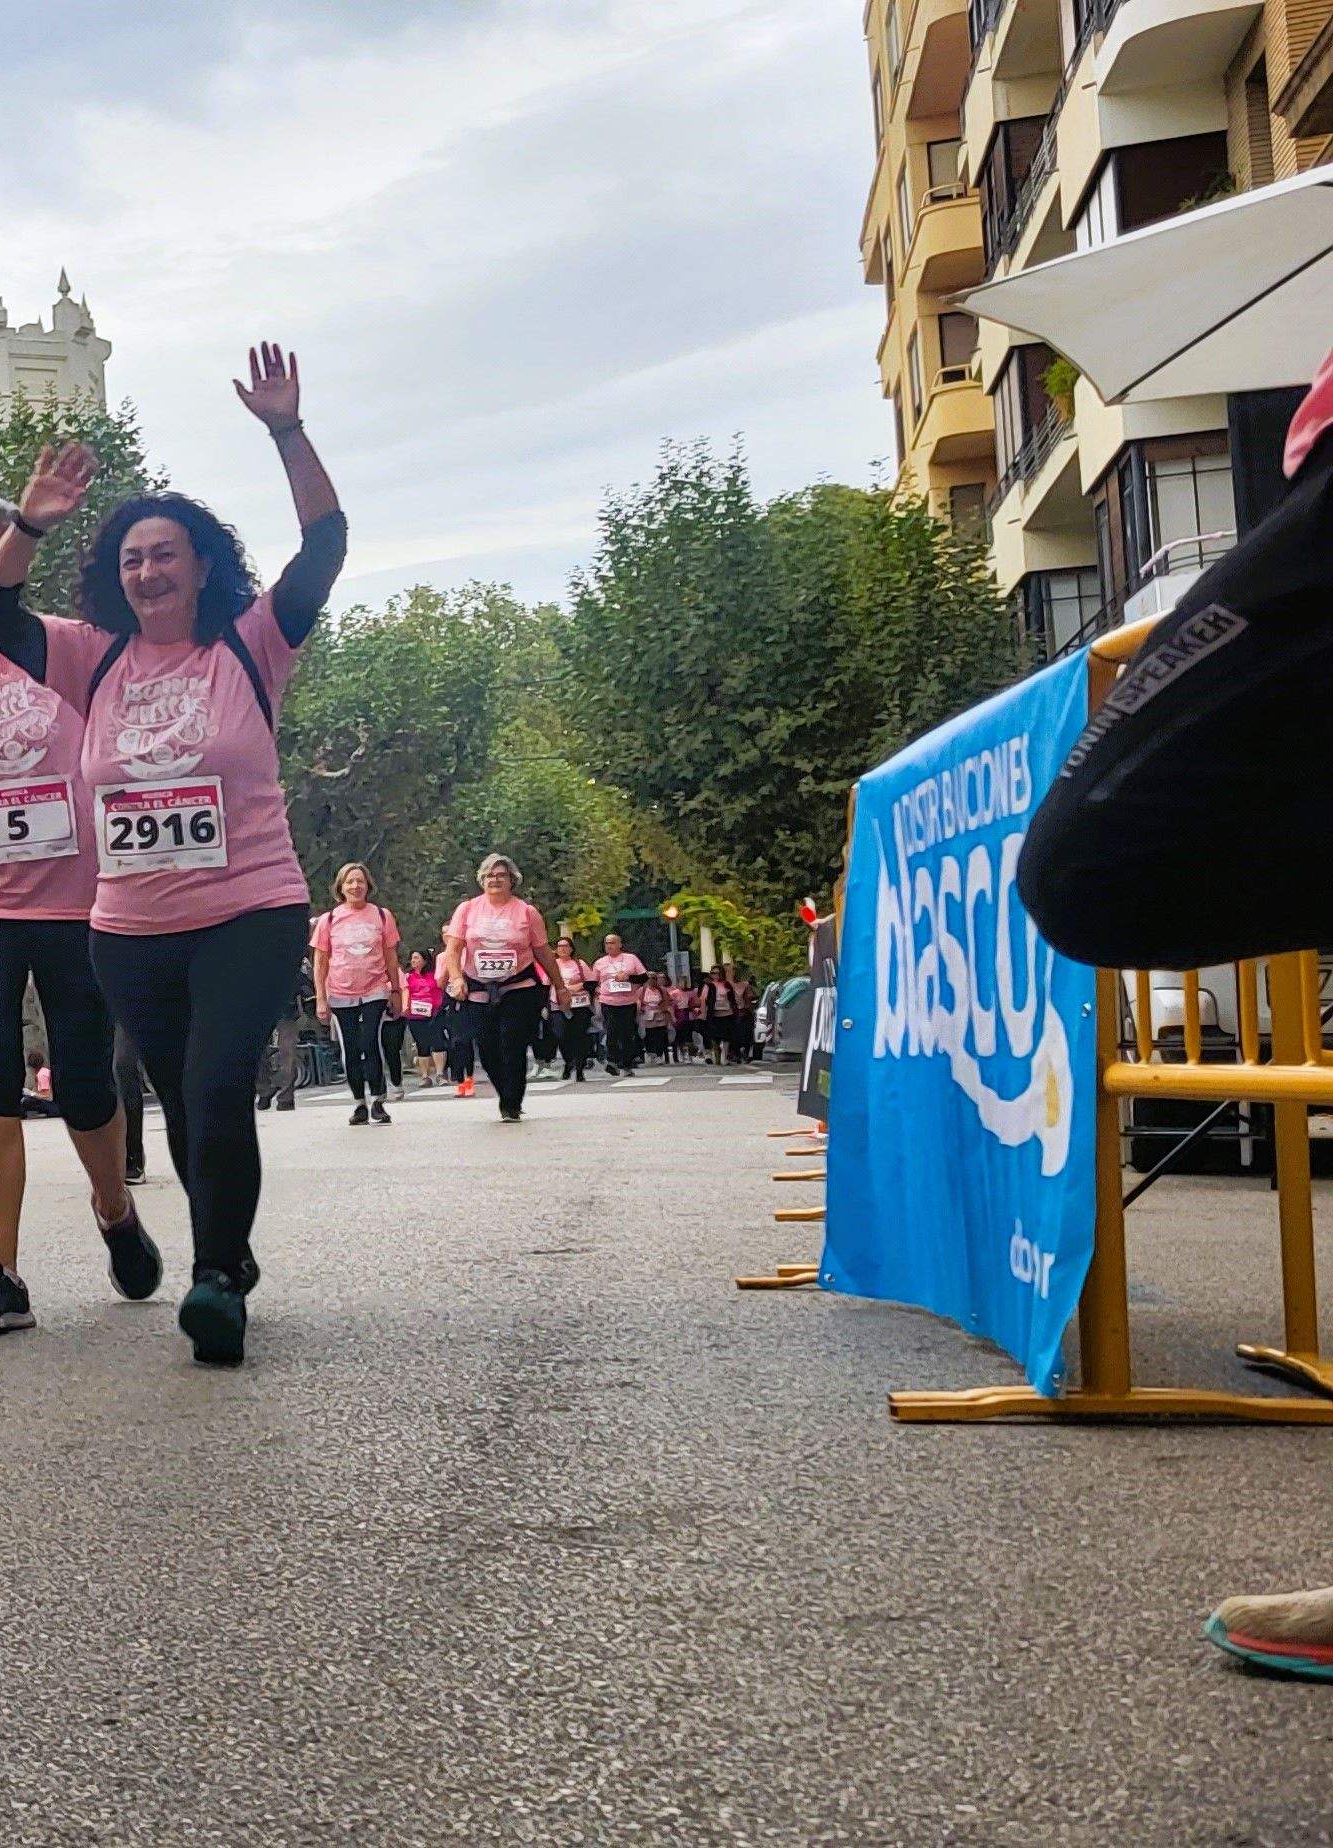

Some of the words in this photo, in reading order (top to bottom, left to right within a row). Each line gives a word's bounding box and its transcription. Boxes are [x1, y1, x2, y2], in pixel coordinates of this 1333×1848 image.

[7, 809, 30, 841] 5
[109, 809, 216, 851] 2916
[479, 959, 514, 971] 2327
